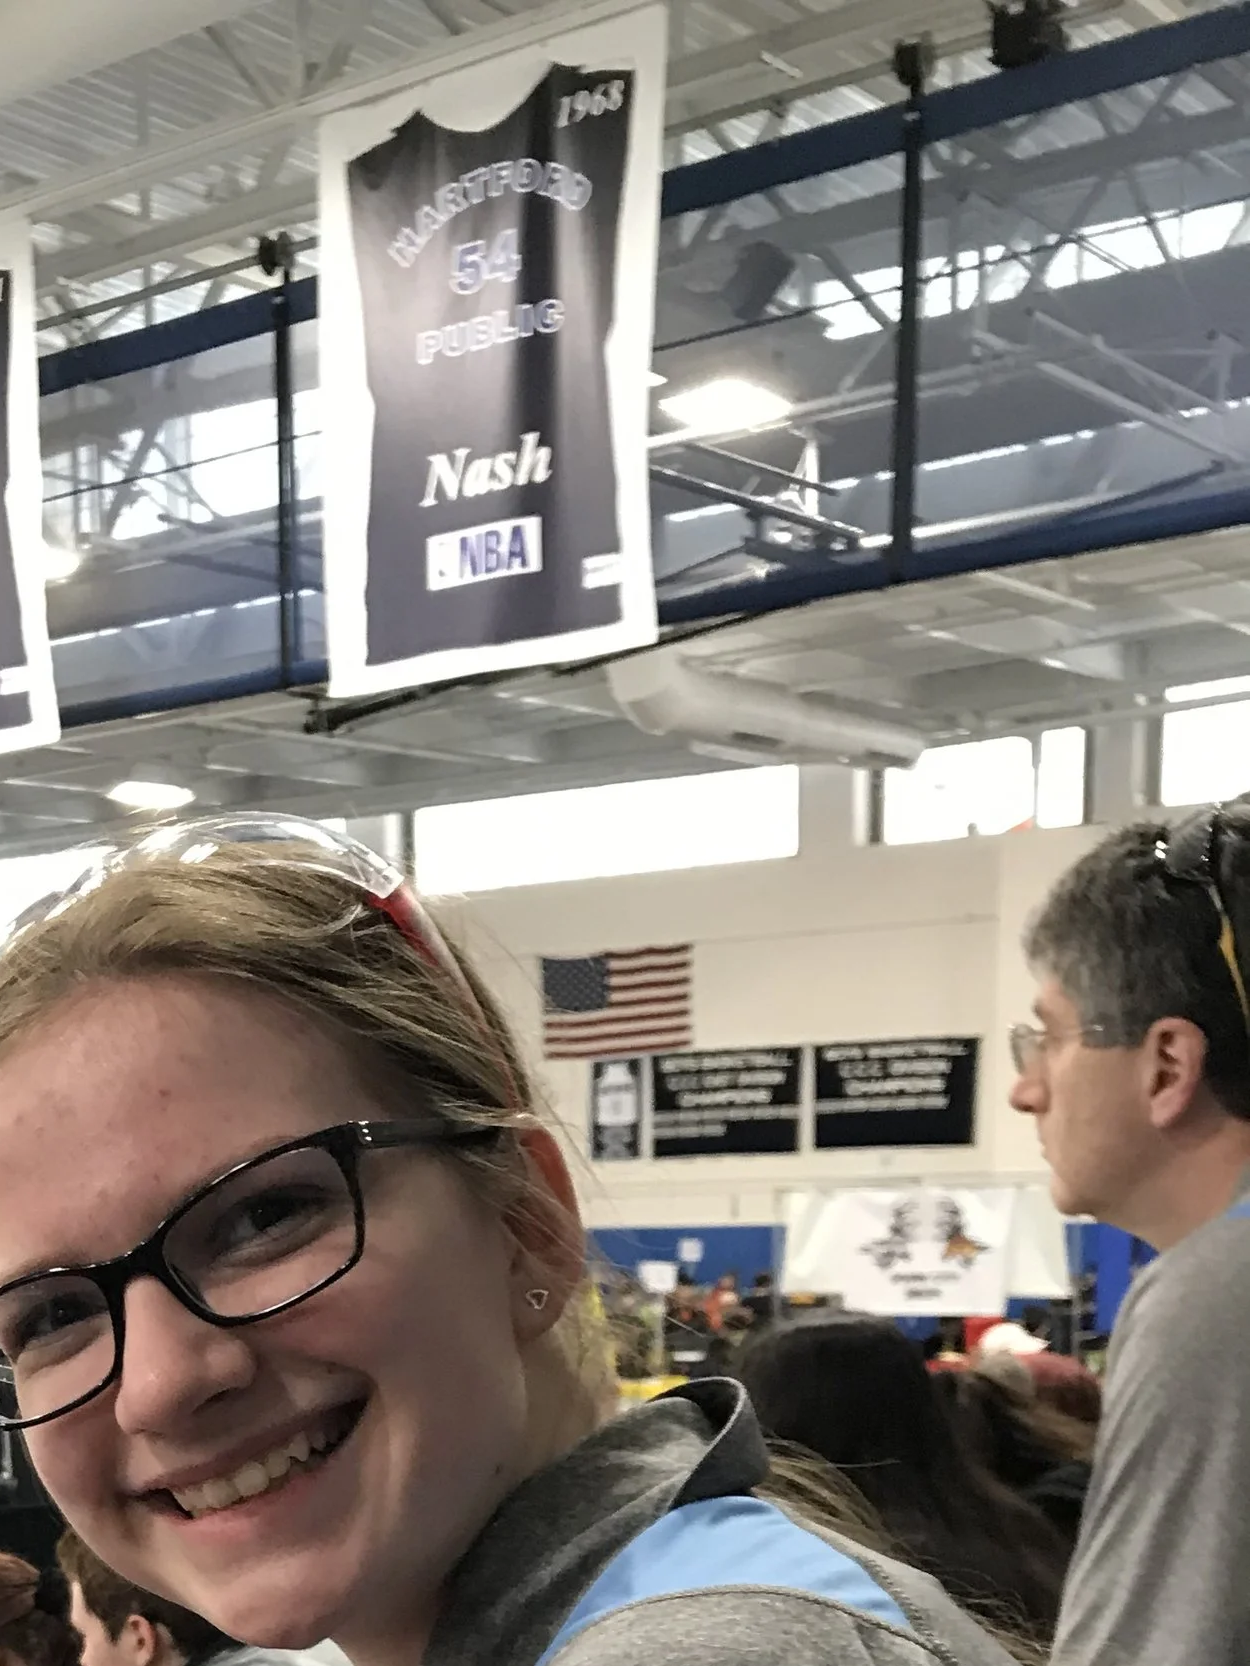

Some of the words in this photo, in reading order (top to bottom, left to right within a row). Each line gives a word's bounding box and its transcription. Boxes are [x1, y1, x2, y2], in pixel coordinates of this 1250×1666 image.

[386, 158, 593, 268] HARTFORD
[449, 227, 523, 295] 54
[415, 298, 566, 365] PUBLIC
[418, 431, 553, 507] Nash
[458, 525, 530, 579] NBA
